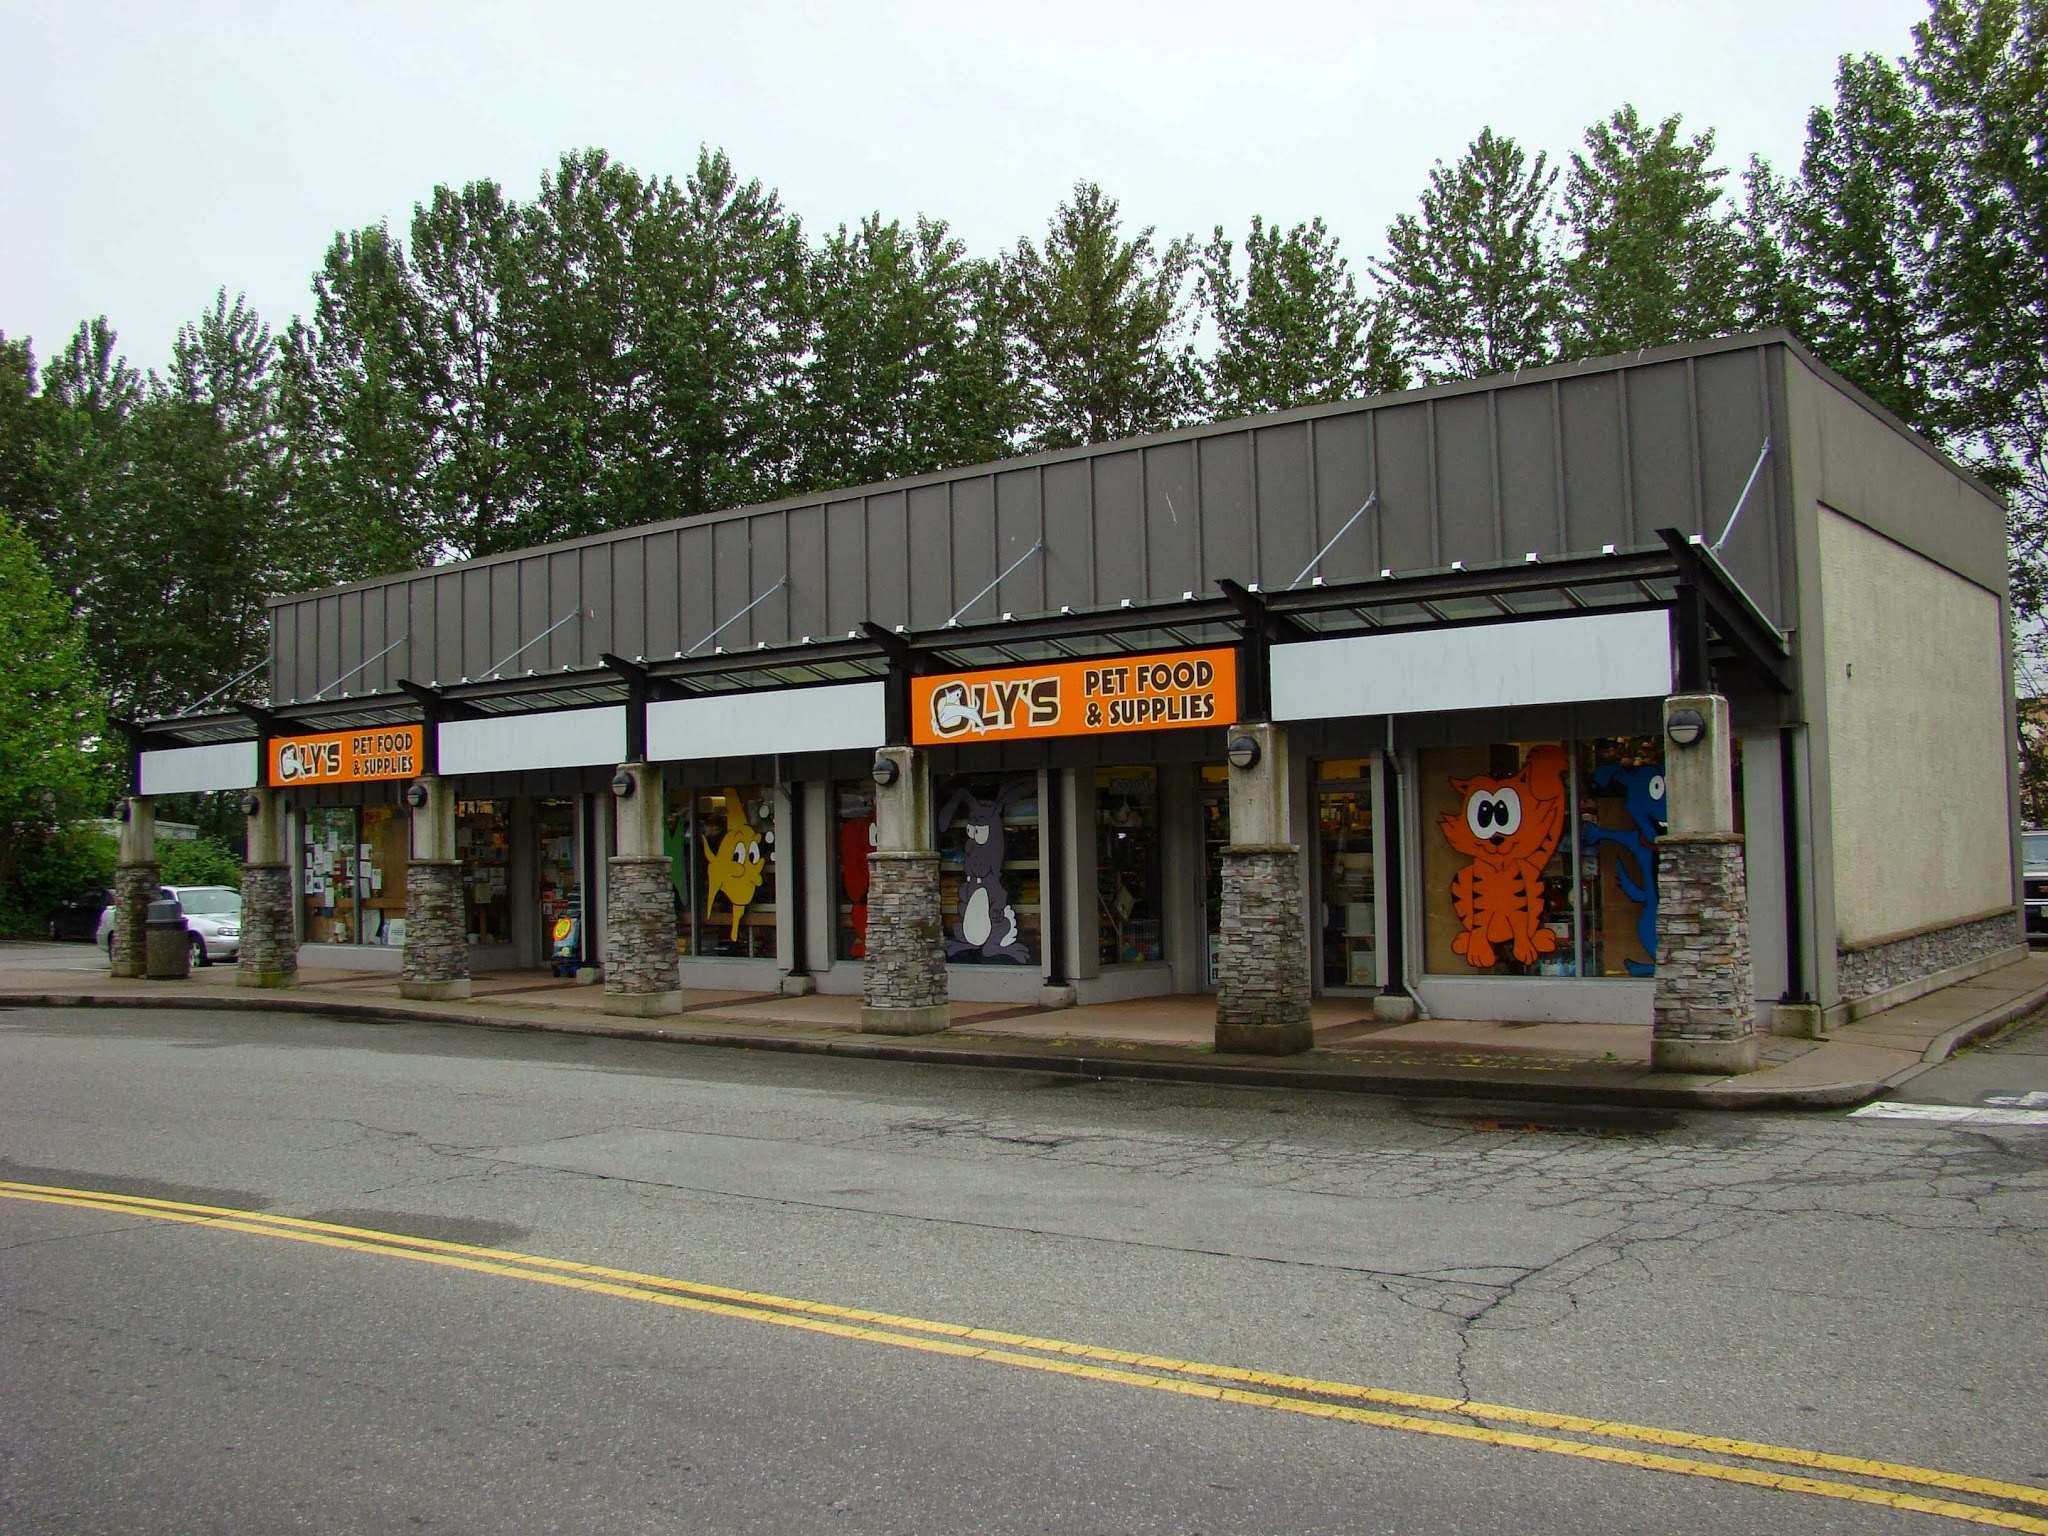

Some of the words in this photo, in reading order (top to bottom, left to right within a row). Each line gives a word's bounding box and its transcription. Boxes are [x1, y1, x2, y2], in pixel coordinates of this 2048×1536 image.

[1085, 667, 1128, 697] PET
[1137, 660, 1214, 693] FOOD
[931, 676, 1060, 738] OLY'S
[1085, 702, 1102, 727] &
[1109, 694, 1214, 726] SUPPLIES
[353, 736, 373, 755] PET
[378, 733, 413, 753] FOOD
[353, 761, 360, 776] &
[364, 756, 413, 775] SUPPLIES
